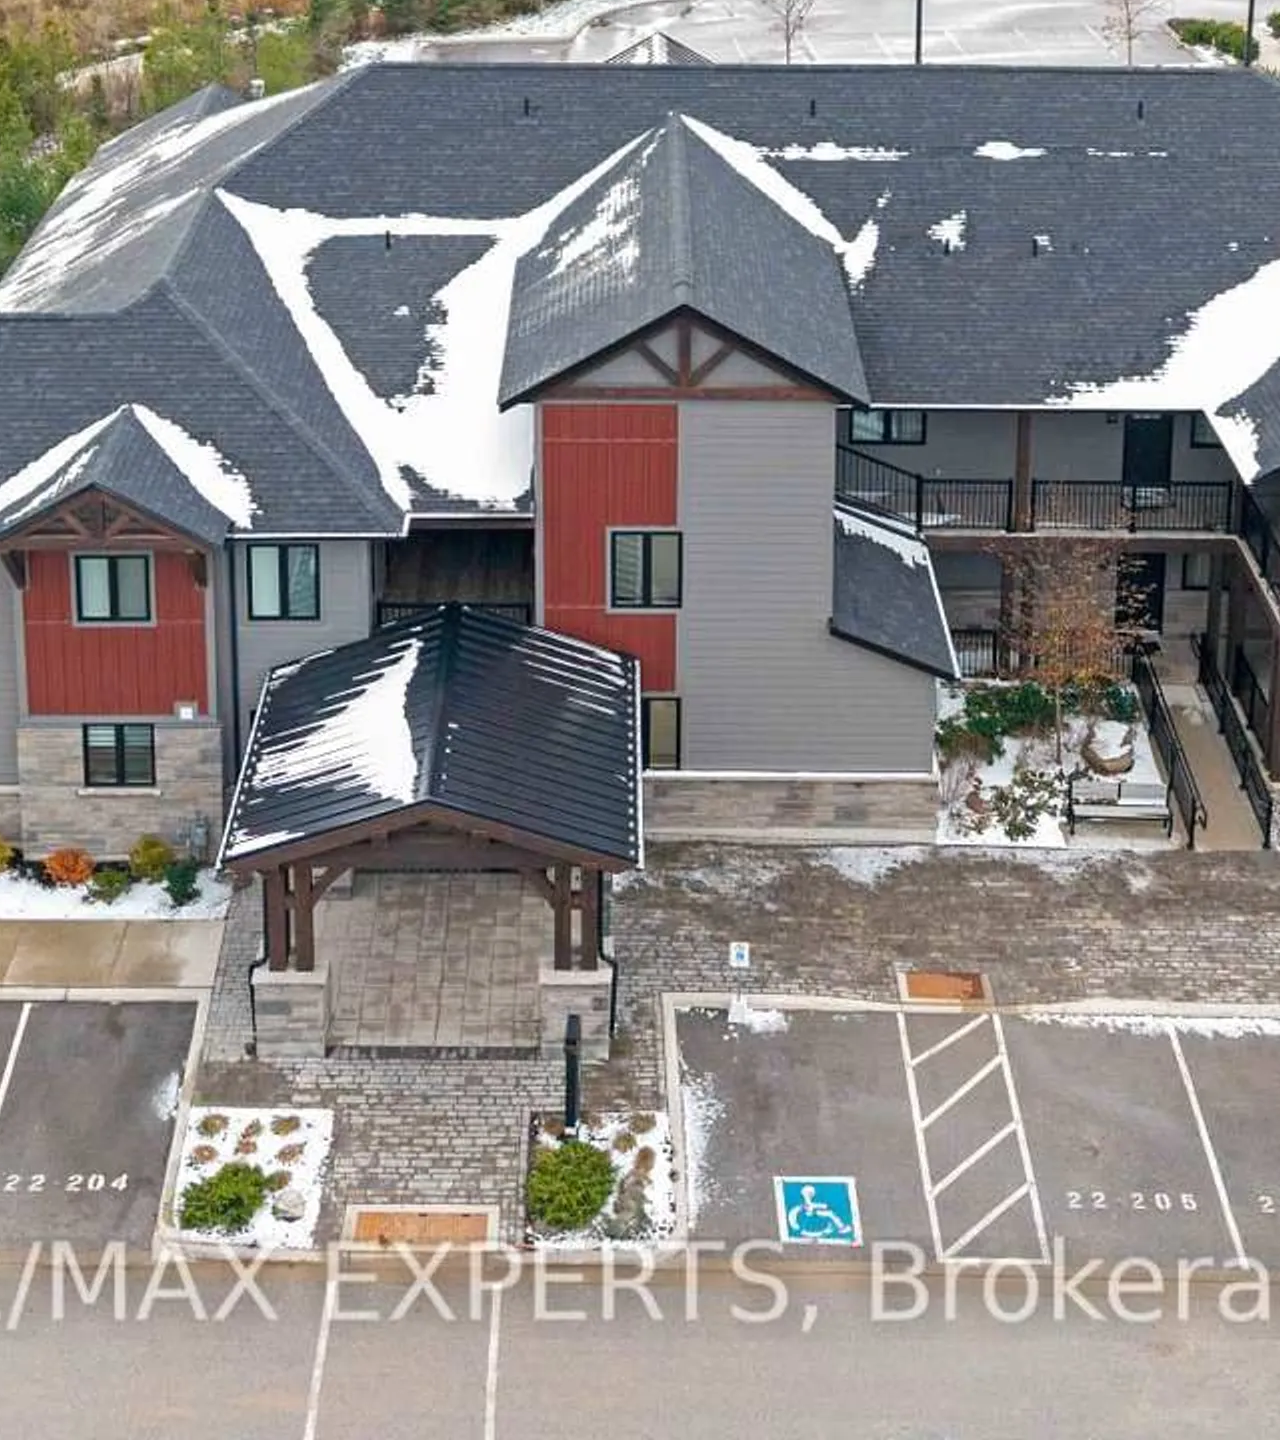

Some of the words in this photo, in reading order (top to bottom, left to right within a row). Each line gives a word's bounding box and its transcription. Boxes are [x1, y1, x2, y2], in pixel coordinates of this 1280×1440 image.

[3, 1173, 46, 1192] 22
[64, 1173, 128, 1191] 204
[1066, 1191, 1107, 1209] 22
[1130, 1192, 1197, 1211] 205
